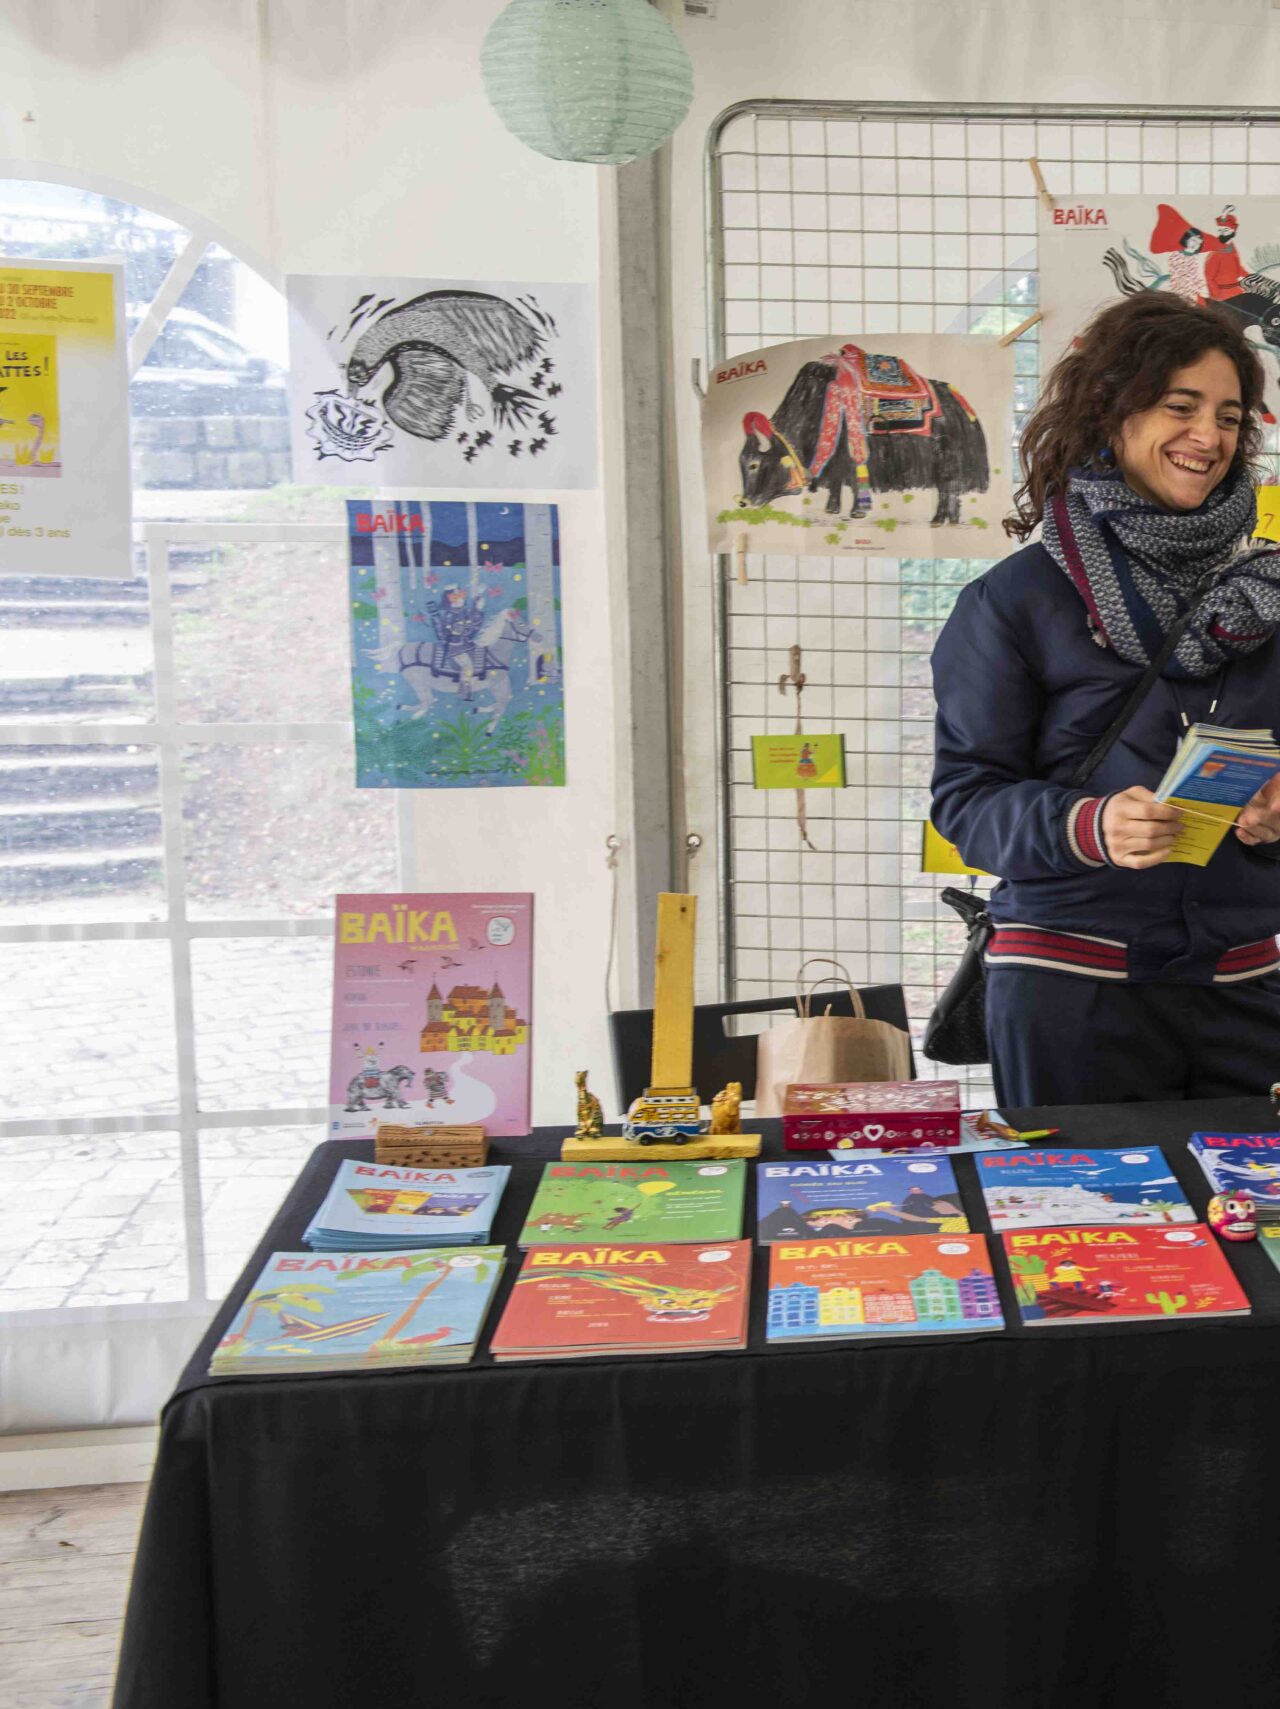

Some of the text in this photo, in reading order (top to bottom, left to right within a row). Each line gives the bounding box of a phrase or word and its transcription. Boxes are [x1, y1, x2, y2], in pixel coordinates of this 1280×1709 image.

[1053, 204, 1108, 225] BAÏKA
[6, 350, 28, 361] LES
[716, 359, 768, 384] BAÏKA
[356, 509, 426, 533] BAÏKA
[34, 528, 44, 538] 3
[340, 904, 460, 944] BAÏKA
[982, 1152, 1097, 1168] BAÏKA
[355, 1166, 457, 1183] BAÏKA
[549, 1165, 670, 1180] BAÏKA
[765, 1163, 883, 1178] BAÏKA
[1010, 1230, 1137, 1247] BAÏKA
[531, 1248, 667, 1266] BAÏKA
[779, 1241, 909, 1260] BAÏKA
[275, 1255, 414, 1272] BAÏKA
